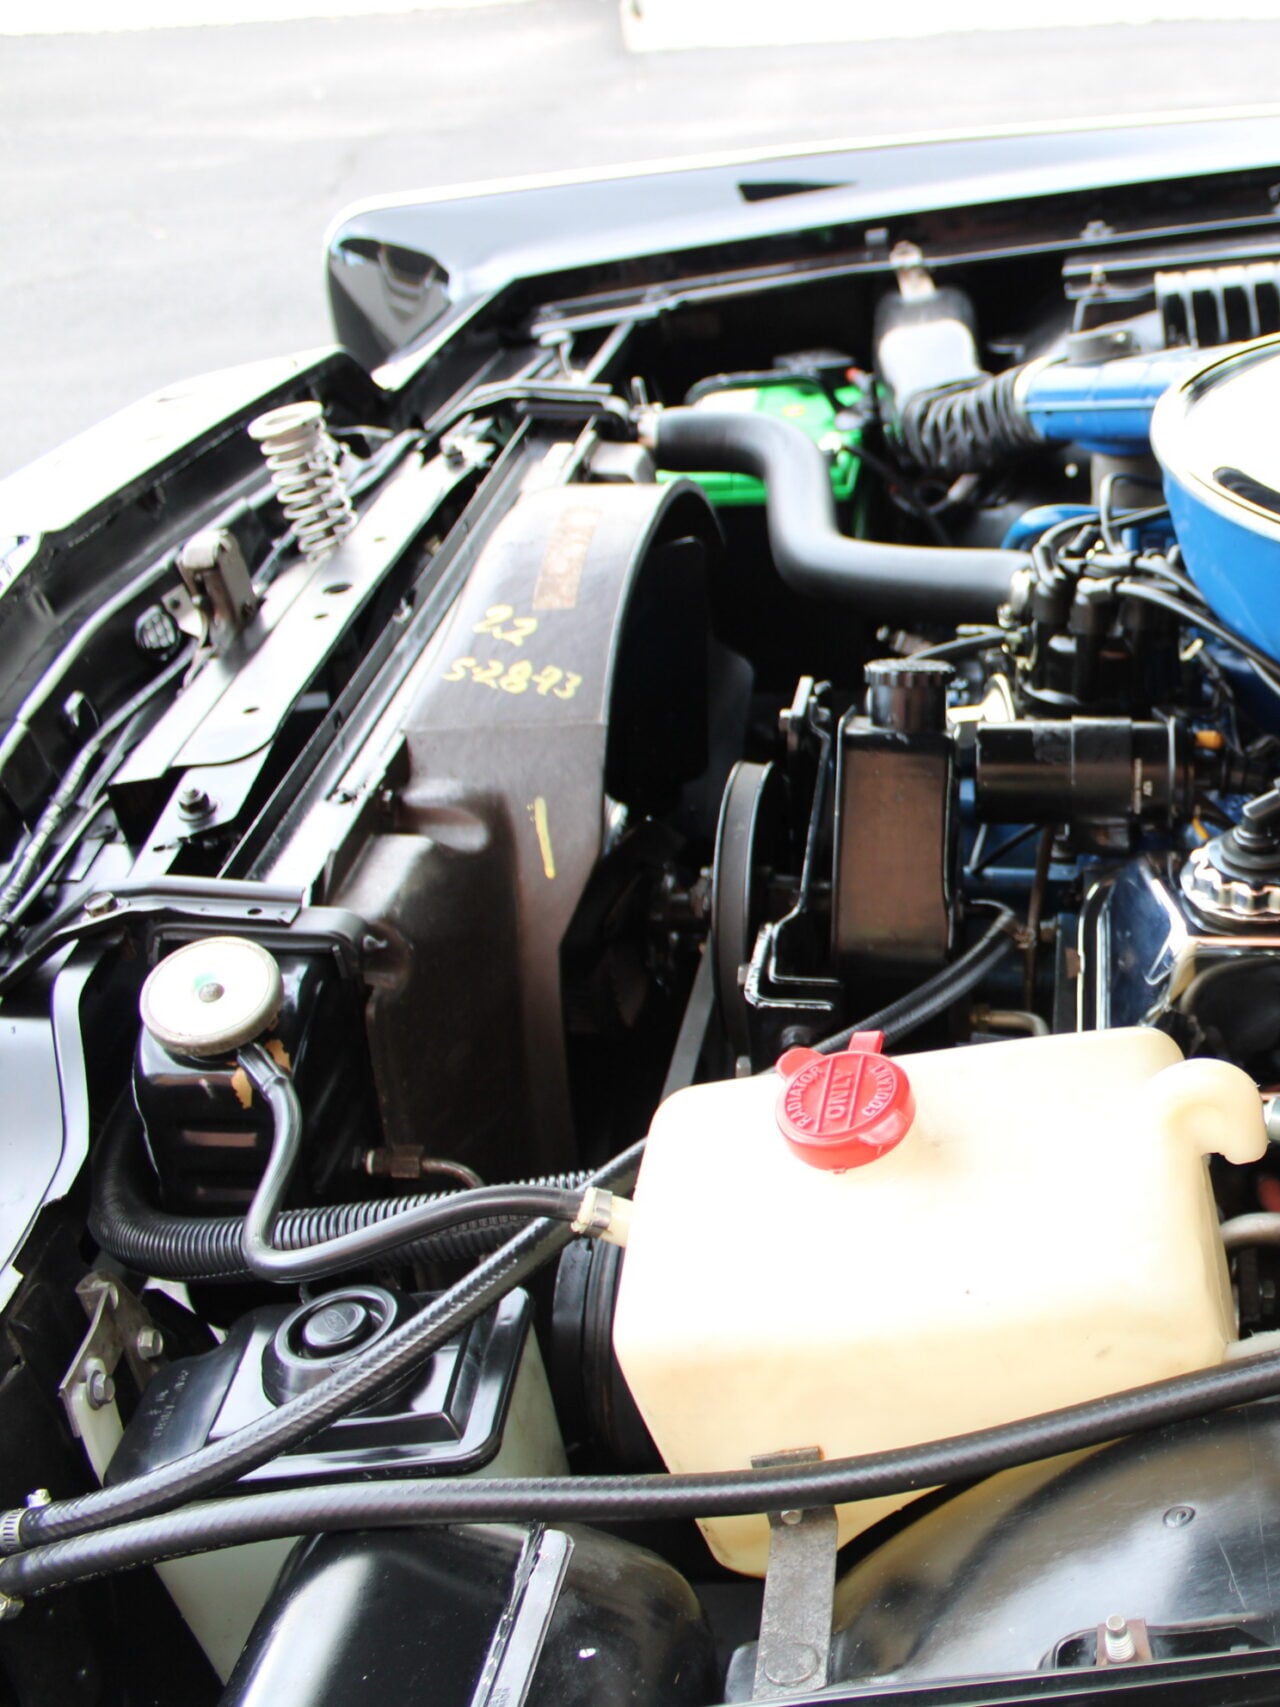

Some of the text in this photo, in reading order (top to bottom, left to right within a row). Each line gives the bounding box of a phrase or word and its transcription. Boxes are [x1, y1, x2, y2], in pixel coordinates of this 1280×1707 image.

[472, 604, 537, 646] 22
[786, 1065, 823, 1128] RADIATOR
[825, 1070, 855, 1120] ONLY
[861, 1064, 894, 1117] COOLANT
